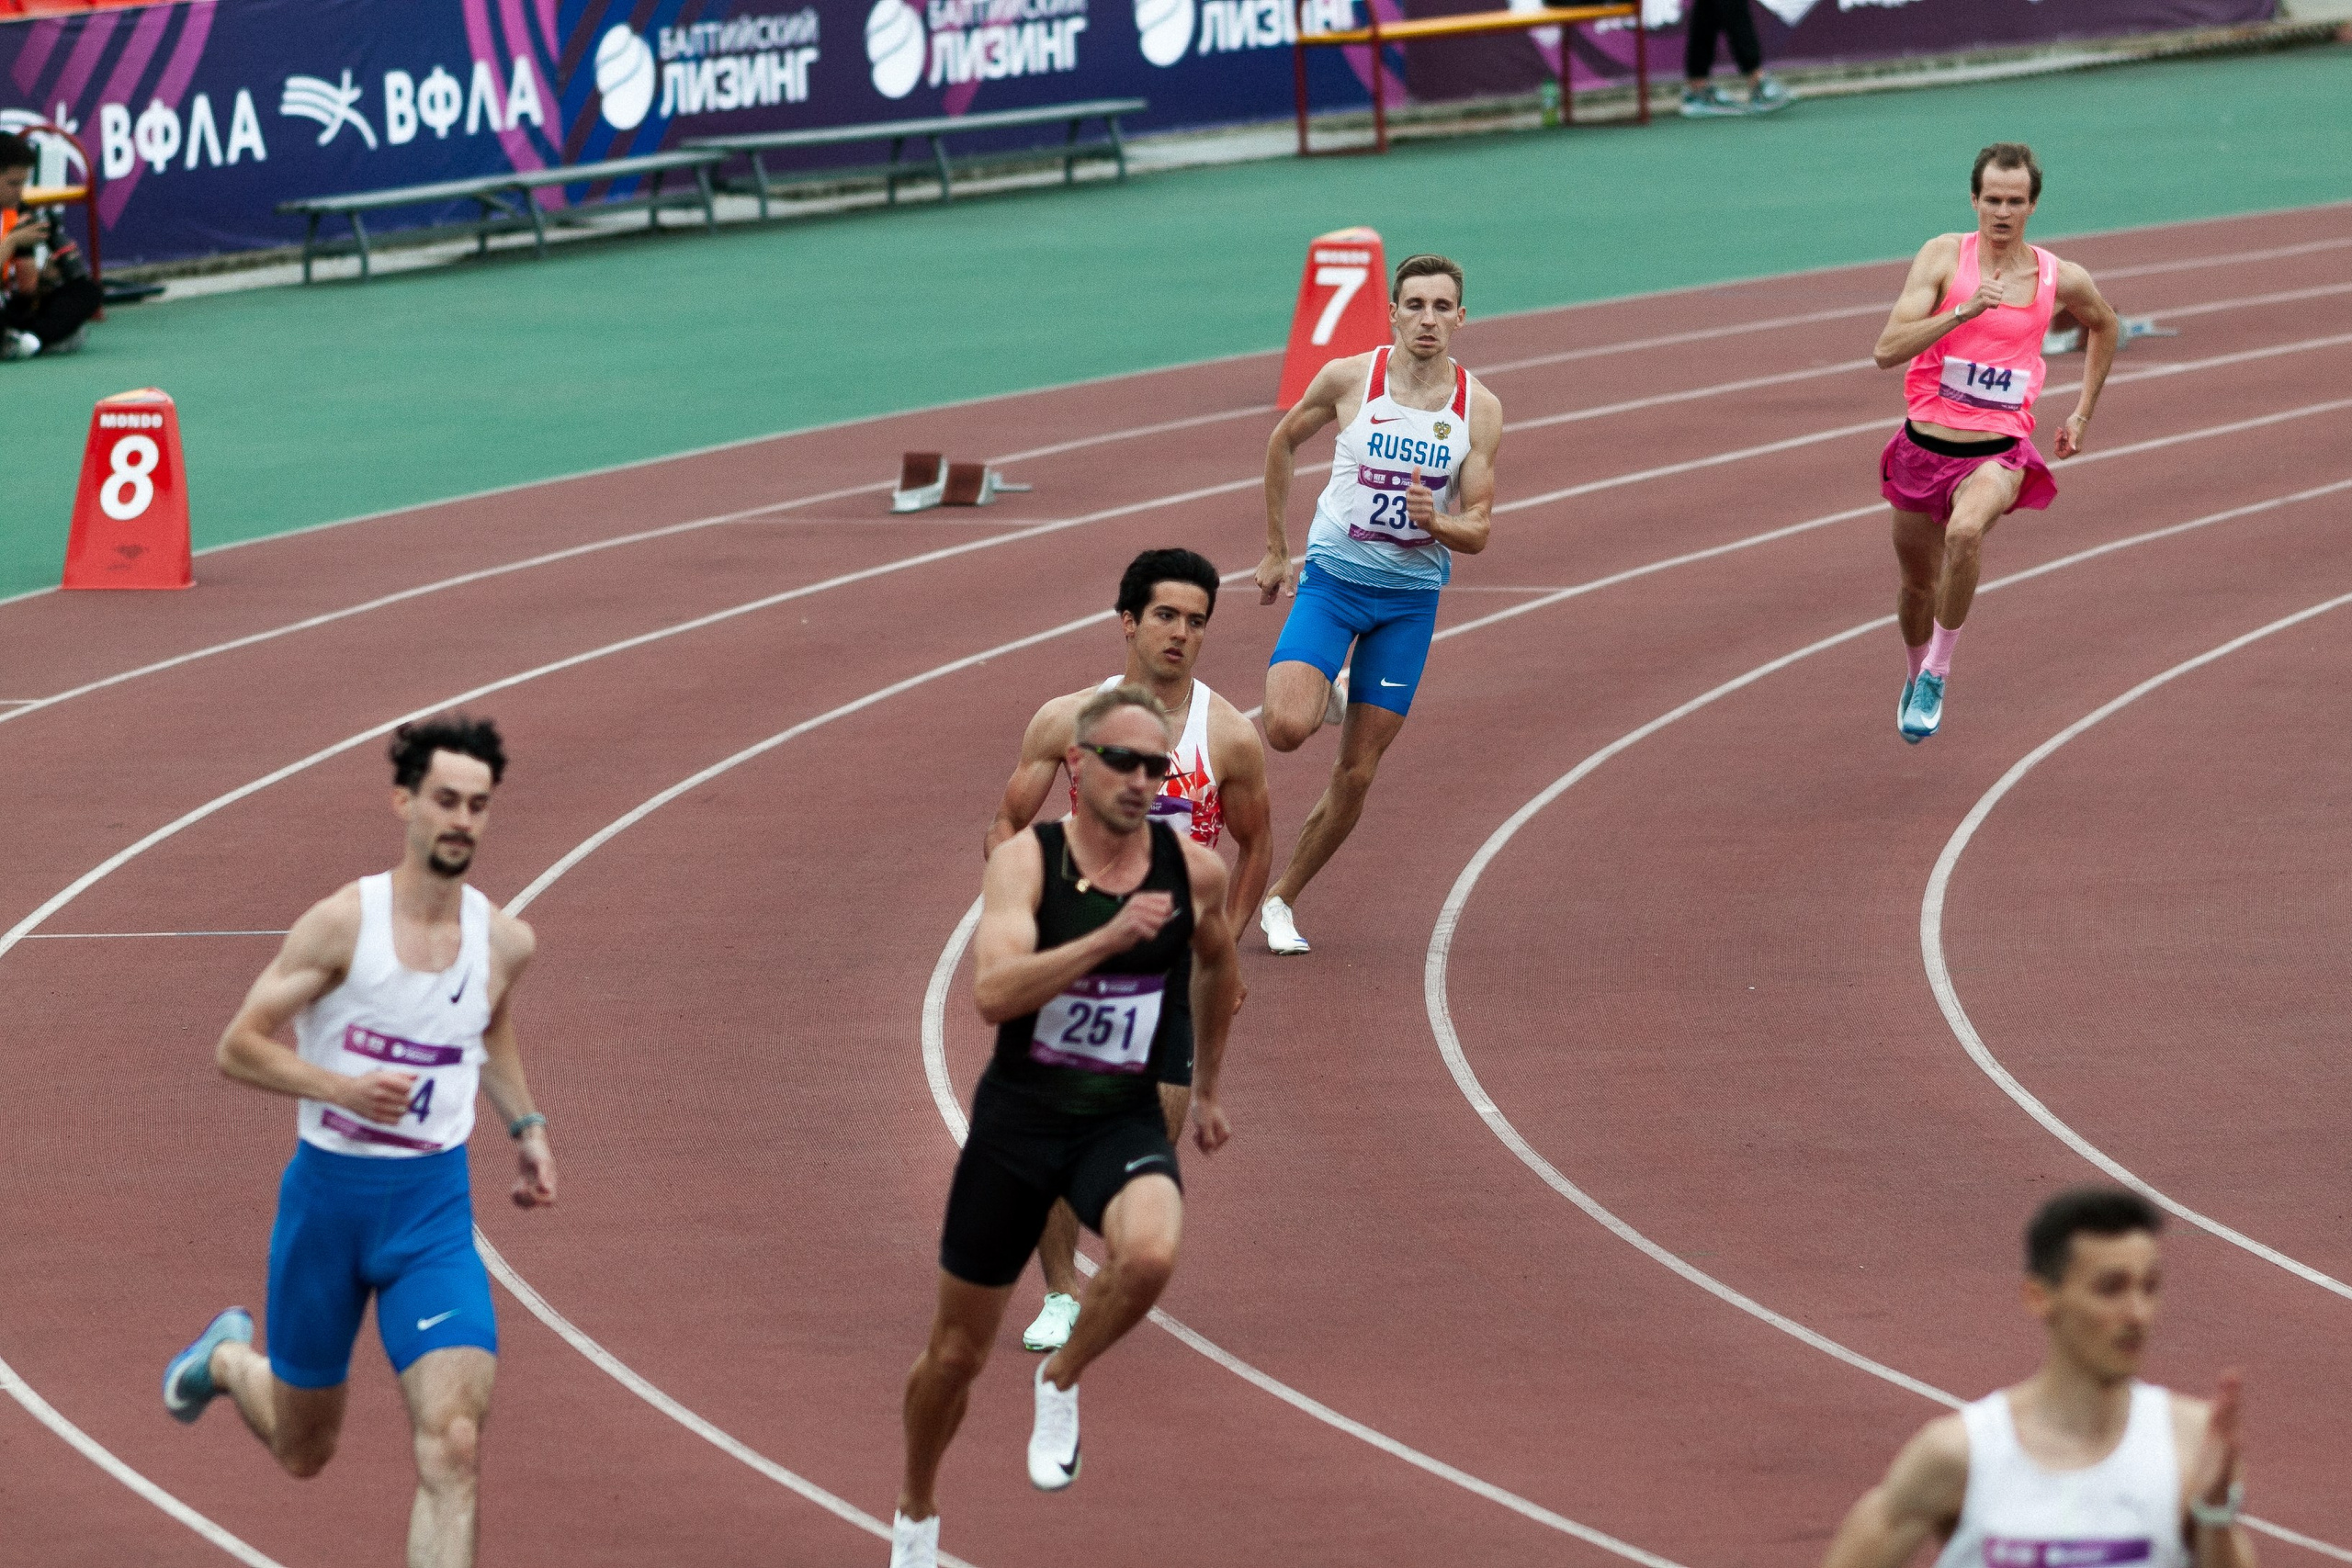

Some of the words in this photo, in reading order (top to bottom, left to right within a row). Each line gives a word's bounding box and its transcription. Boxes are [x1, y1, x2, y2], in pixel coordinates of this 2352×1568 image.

[658, 6, 820, 61] БАЛТИЙСКИЙ
[928, 16, 1088, 88] ЛИЗИНГ
[384, 53, 546, 145] ВФЛА
[659, 47, 820, 119] ЛИЗИНГ
[100, 87, 267, 180] ВФЛА
[1311, 266, 1369, 346] 7
[1966, 362, 2012, 392] 144
[99, 434, 160, 521] 8
[1367, 432, 1452, 469] RUSSIA
[1369, 492, 1419, 530] 23
[1061, 1000, 1137, 1052] 251
